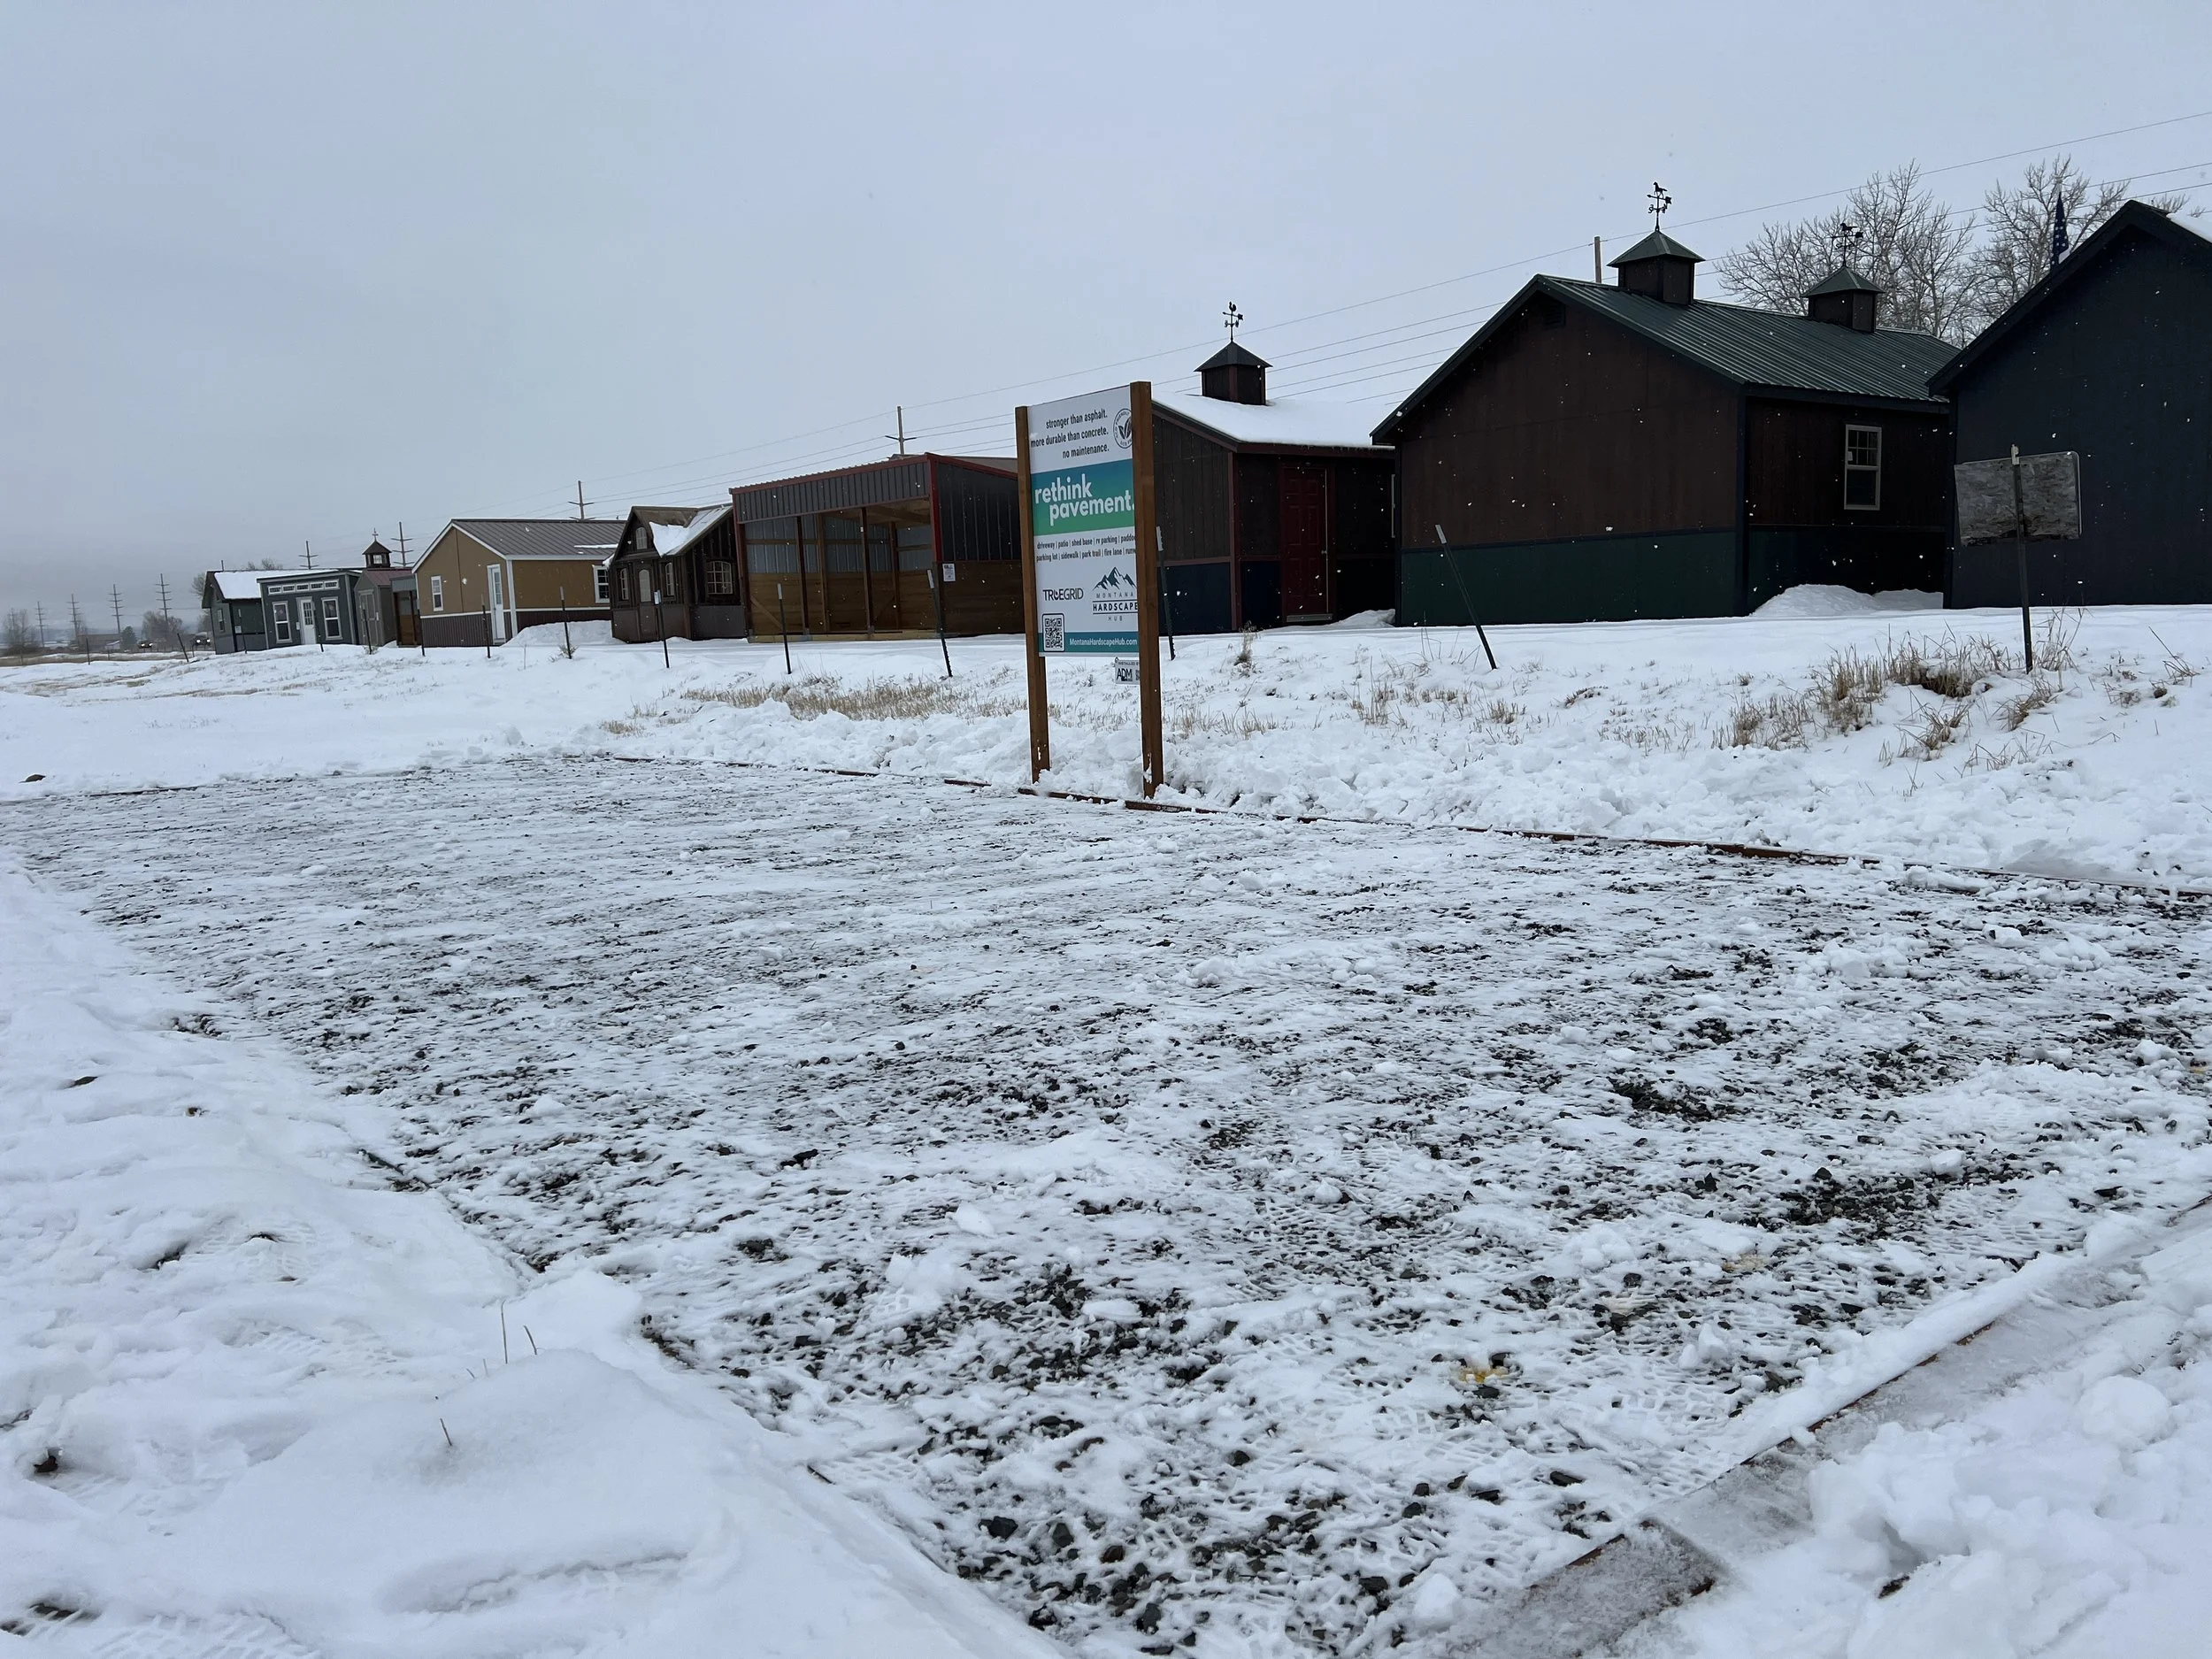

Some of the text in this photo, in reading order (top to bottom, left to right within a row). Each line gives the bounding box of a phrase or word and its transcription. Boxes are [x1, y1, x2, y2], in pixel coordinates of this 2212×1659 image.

[1046, 409, 1108, 429] stronger than asphalt.
[1031, 427, 1109, 448] more durable than concrete.
[1062, 444, 1110, 459] no maintenance.
[1035, 473, 1093, 504] rethink
[1050, 489, 1135, 526] pavement.
[1058, 541, 1068, 549] patio
[1071, 538, 1082, 546] shed
[1101, 535, 1117, 545] parking
[1036, 554, 1052, 562] parking
[1061, 551, 1079, 560] sidewalk
[1082, 550, 1091, 559] park
[1093, 602, 1138, 611] HARDSCAPE
[1069, 637, 1138, 647] MontanaHardscapeHub.com
[1117, 668, 1133, 680] ADM
